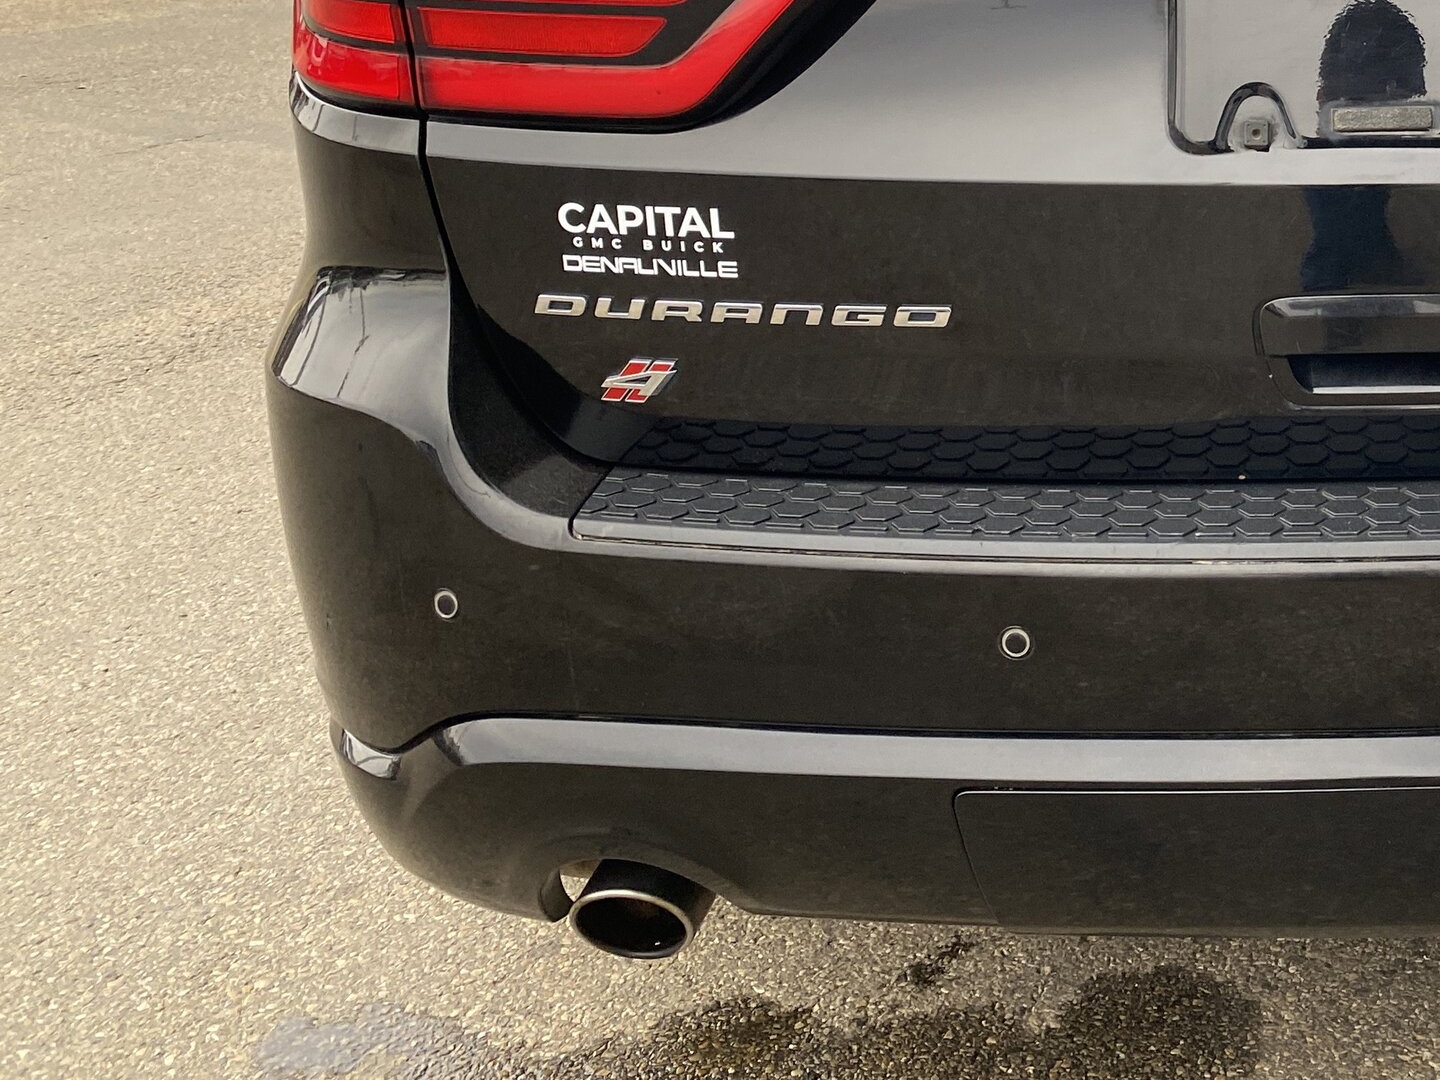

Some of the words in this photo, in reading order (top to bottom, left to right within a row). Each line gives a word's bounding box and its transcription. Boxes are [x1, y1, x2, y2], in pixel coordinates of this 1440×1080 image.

[557, 202, 736, 239] CAPITAL
[572, 236, 623, 250] GMC
[642, 239, 725, 254] BUICK
[534, 294, 952, 328] DURANGO
